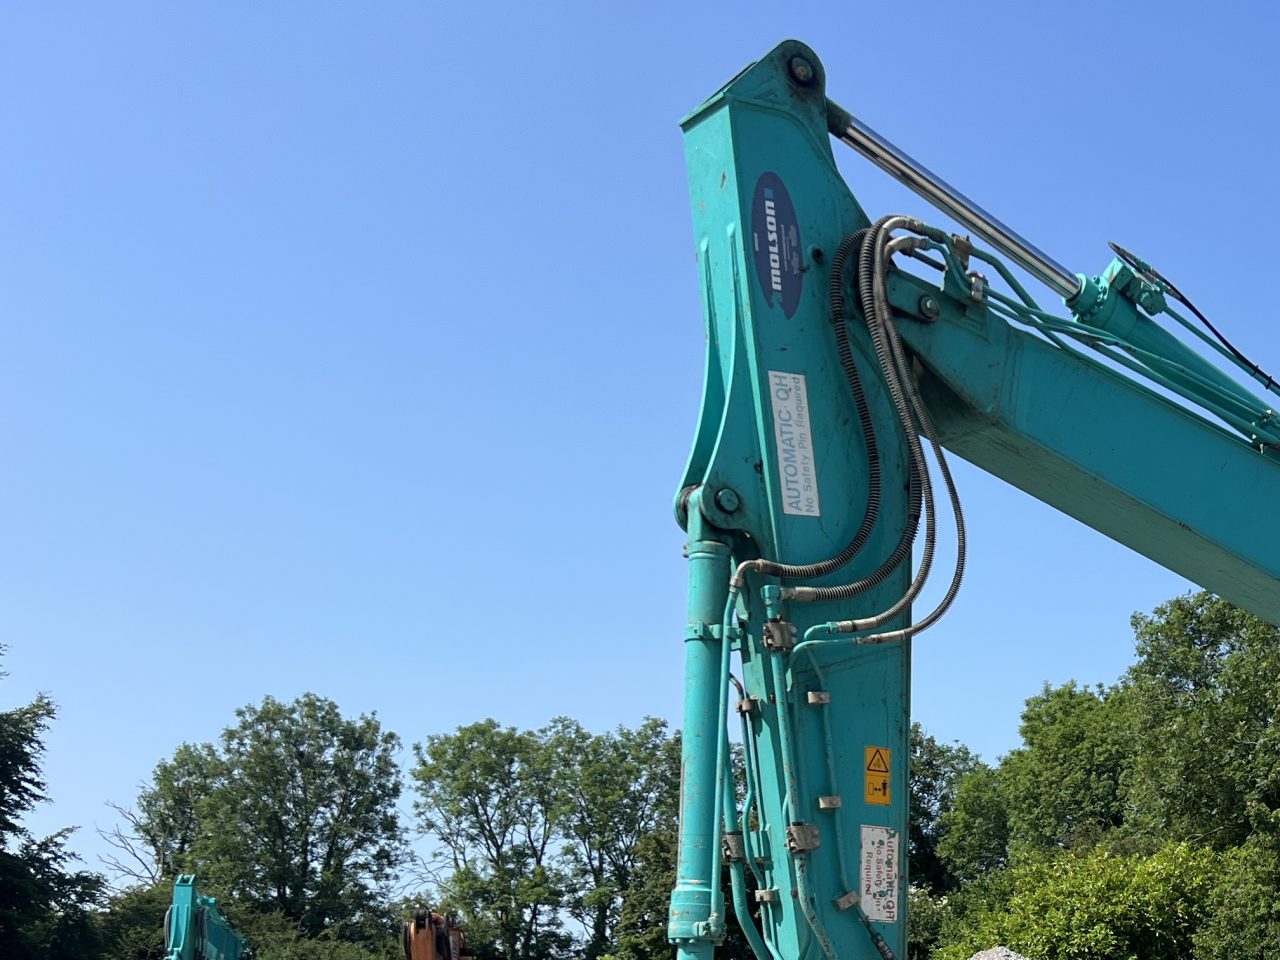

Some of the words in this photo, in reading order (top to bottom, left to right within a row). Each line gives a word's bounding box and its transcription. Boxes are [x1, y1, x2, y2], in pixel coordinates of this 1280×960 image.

[764, 200, 782, 291] MOLSON
[773, 374, 790, 401] QH
[798, 433, 807, 449] Pin
[777, 409, 802, 511] AUTOMATIC
[800, 455, 813, 492] Safety
[805, 497, 815, 513] No
[864, 852, 874, 896] Required
[874, 858, 884, 888] Safety
[886, 900, 895, 920] QH
